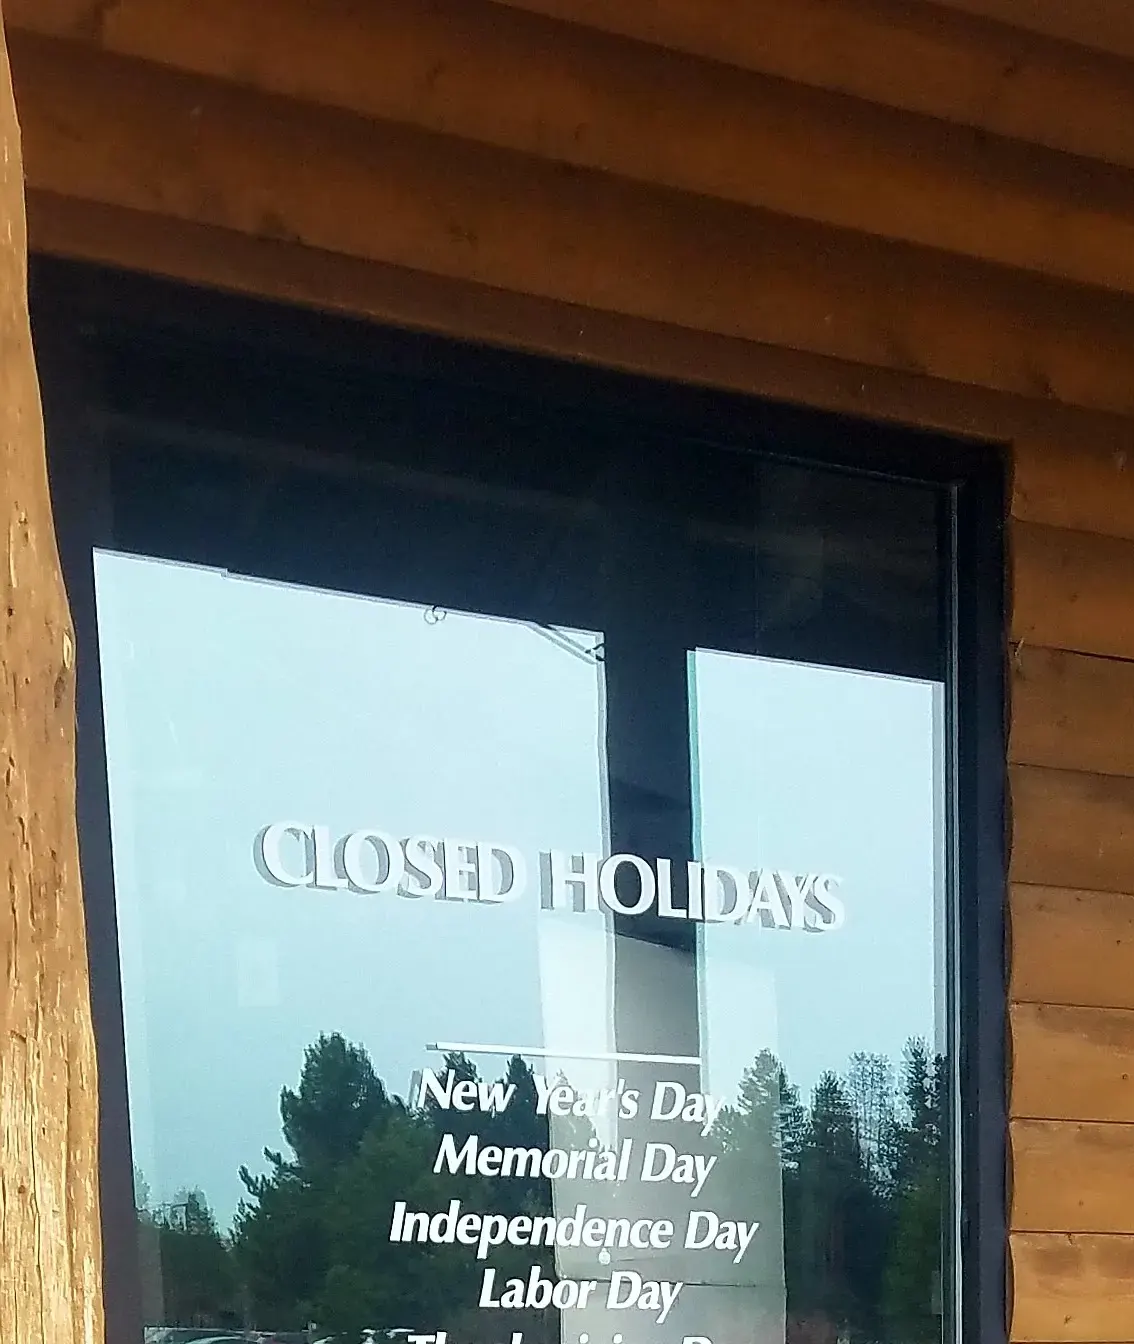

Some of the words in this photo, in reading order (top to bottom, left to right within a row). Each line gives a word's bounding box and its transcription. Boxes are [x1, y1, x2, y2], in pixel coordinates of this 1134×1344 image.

[253, 820, 527, 904] CLOSED
[540, 848, 846, 932] HOLIDAYS
[414, 1067, 516, 1113] New
[534, 1076, 640, 1120] Year's
[650, 1081, 726, 1136] Day
[433, 1133, 633, 1182] Memorial
[641, 1143, 718, 1197] Day
[389, 1200, 673, 1259] Independence
[685, 1210, 760, 1264] Day
[479, 1265, 598, 1310] Labor
[606, 1270, 683, 1323] Day
